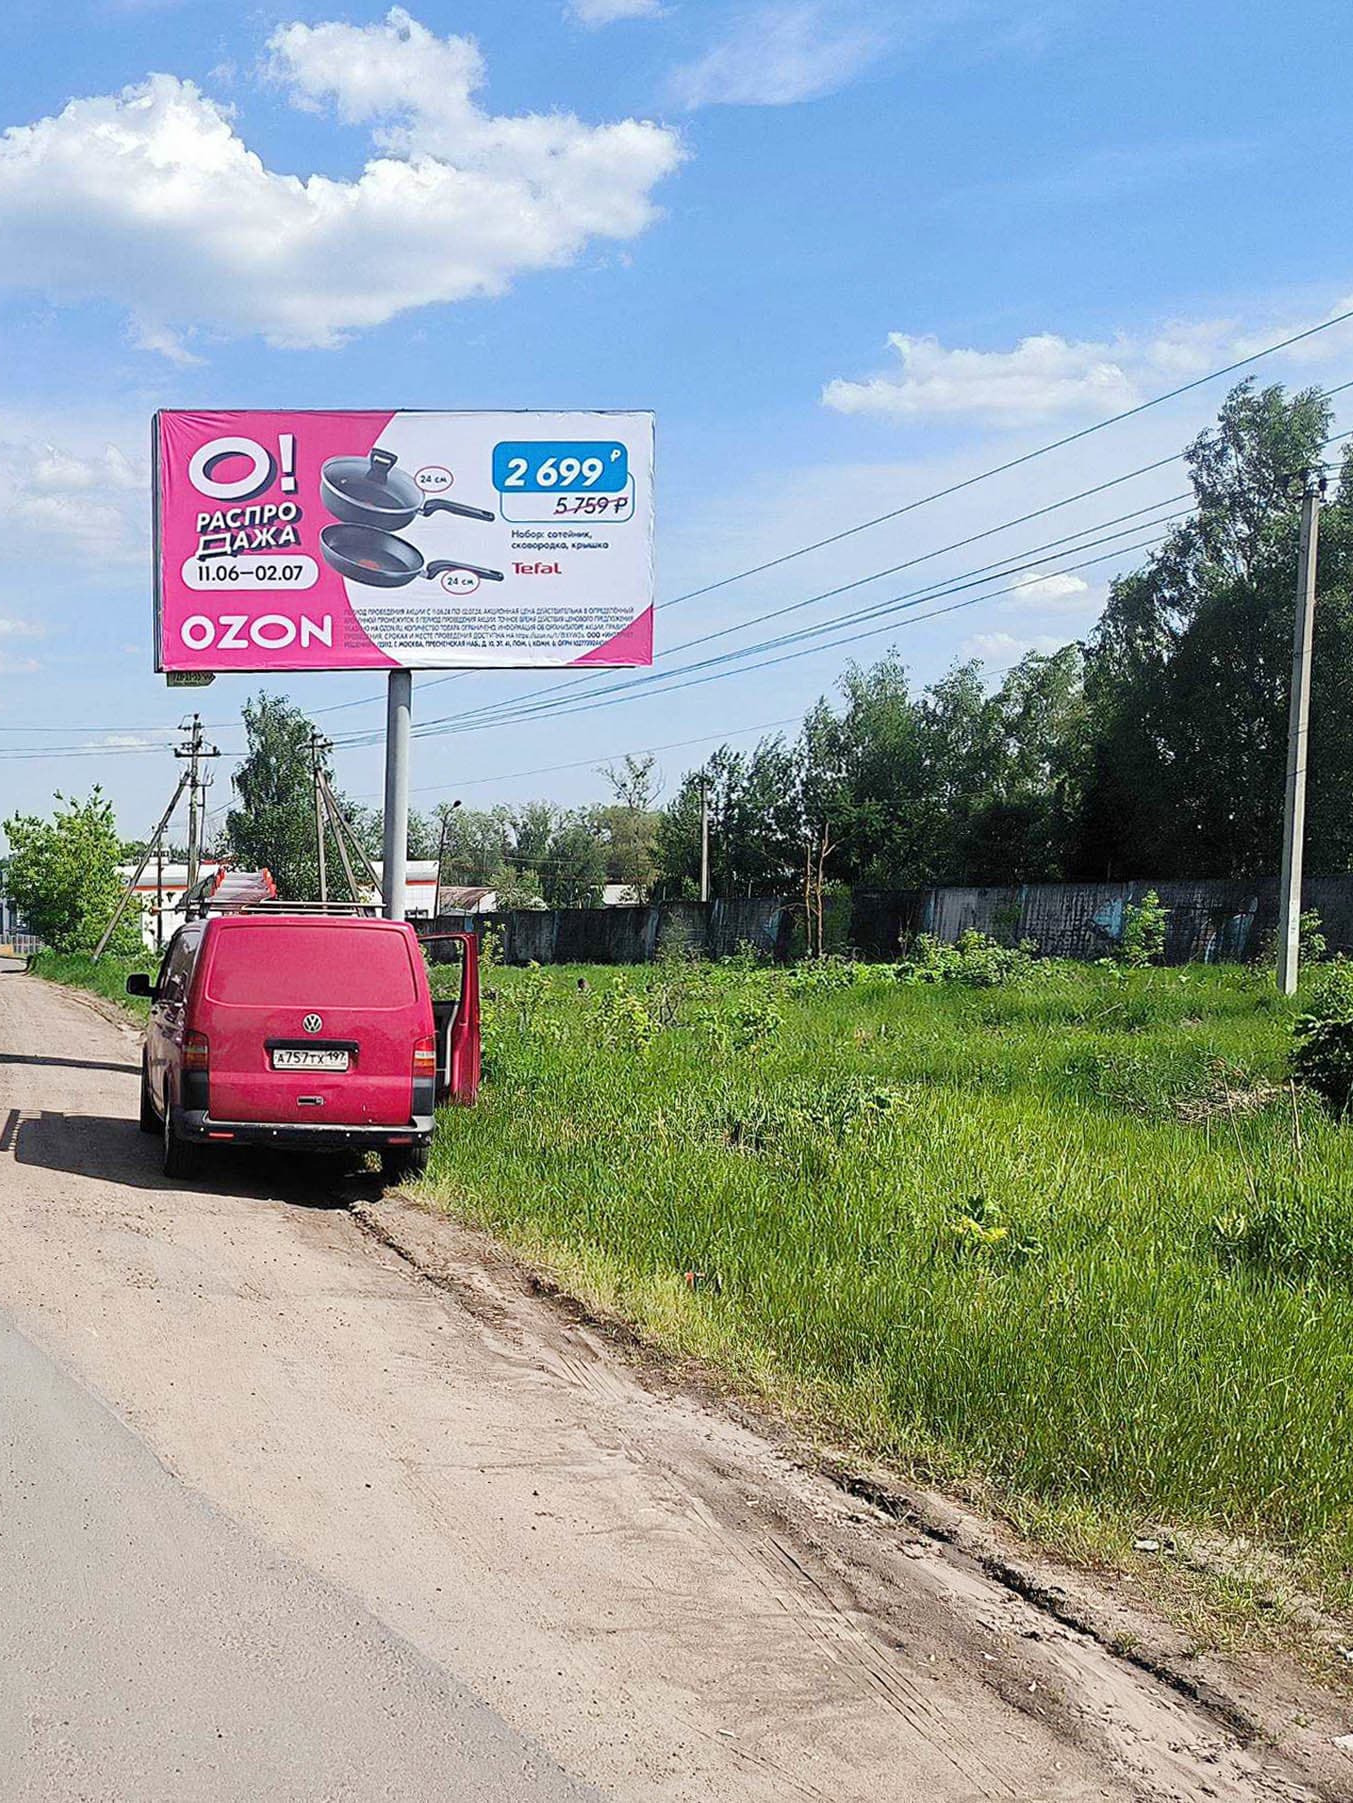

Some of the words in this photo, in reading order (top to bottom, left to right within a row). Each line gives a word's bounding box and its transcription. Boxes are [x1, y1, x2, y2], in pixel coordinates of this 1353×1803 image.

[536, 457, 604, 487] 699
[420, 475, 432, 484] 24
[434, 476, 448, 484] см
[573, 497, 609, 514] 759
[196, 501, 298, 532] РАСПРО
[196, 525, 298, 558] ДАЖА
[511, 529, 544, 540] Набор:
[547, 529, 592, 540] сотейник,
[511, 541, 569, 551] сковородка,
[571, 541, 609, 551] крышка
[512, 562, 562, 574] Tefal
[447, 577, 459, 586] 24
[181, 614, 332, 650] OZON
